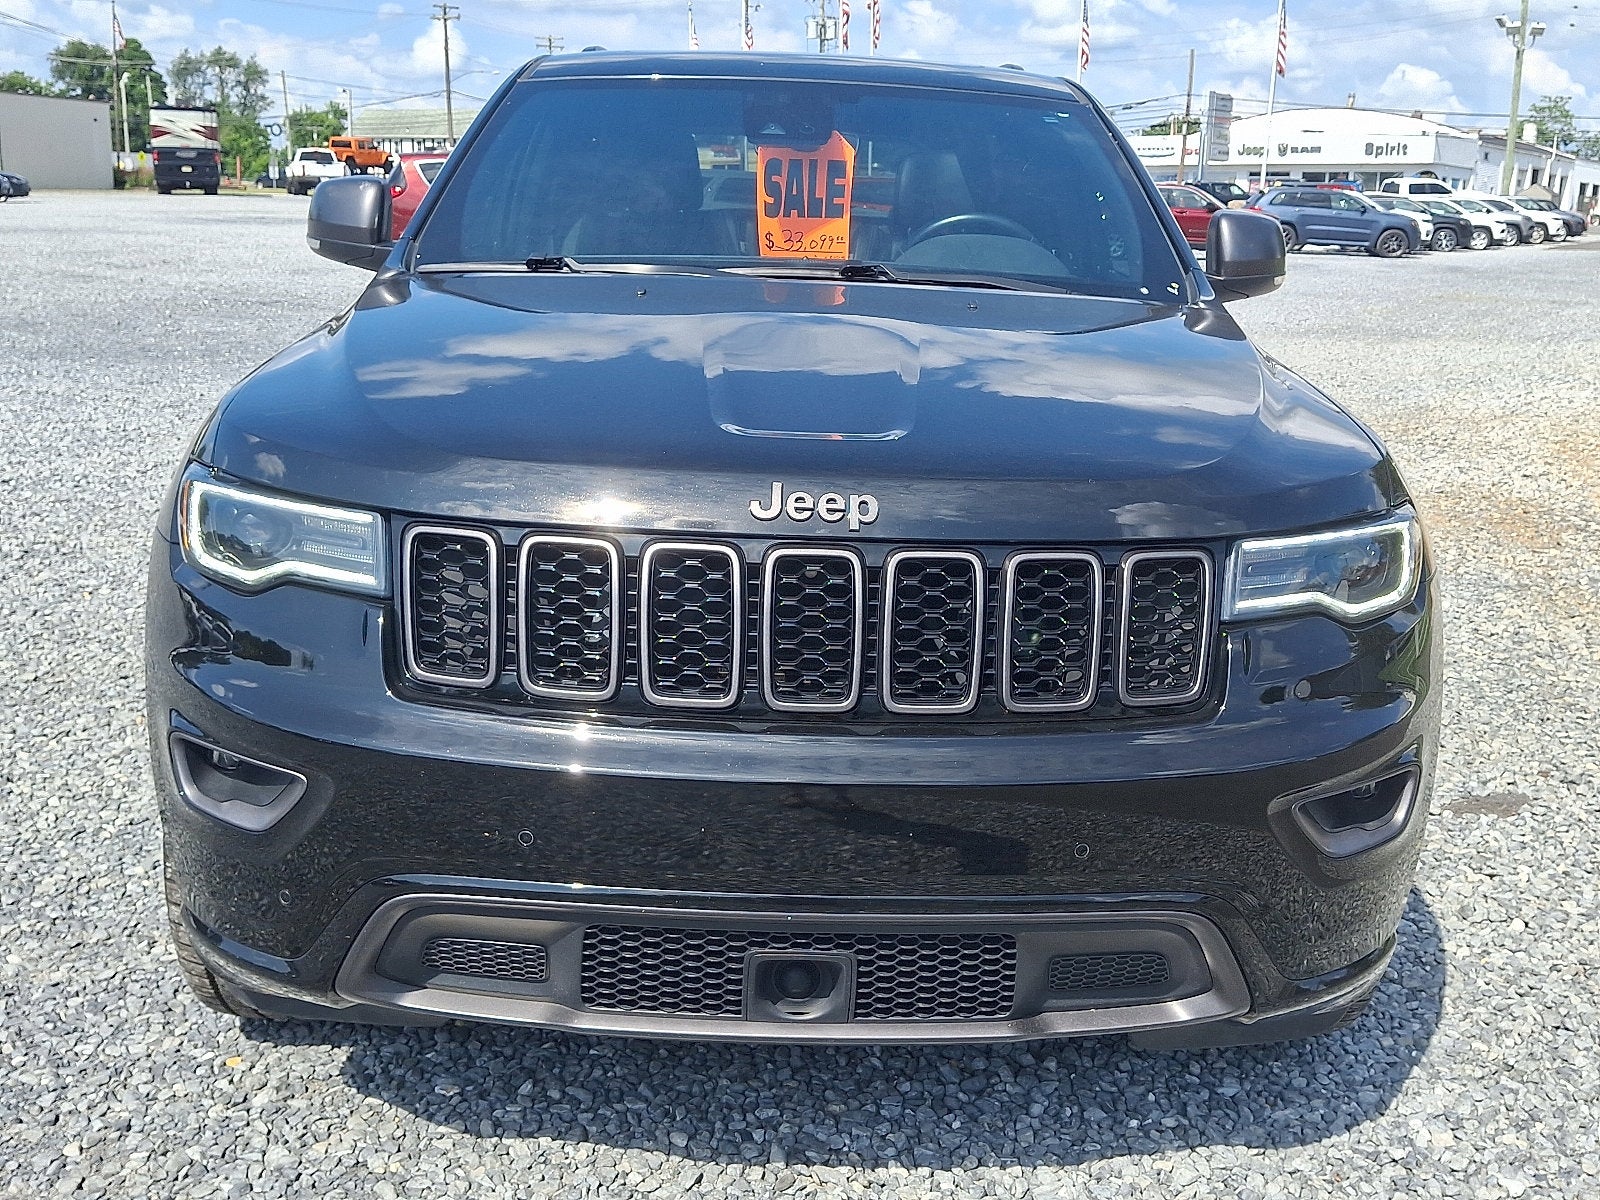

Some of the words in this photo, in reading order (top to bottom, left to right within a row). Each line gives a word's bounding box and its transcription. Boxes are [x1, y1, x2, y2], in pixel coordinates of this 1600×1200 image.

[1238, 143, 1265, 158] Jeep
[1364, 142, 1408, 158] Spirit
[763, 157, 847, 218] SALE
[748, 481, 880, 532] Jeep
